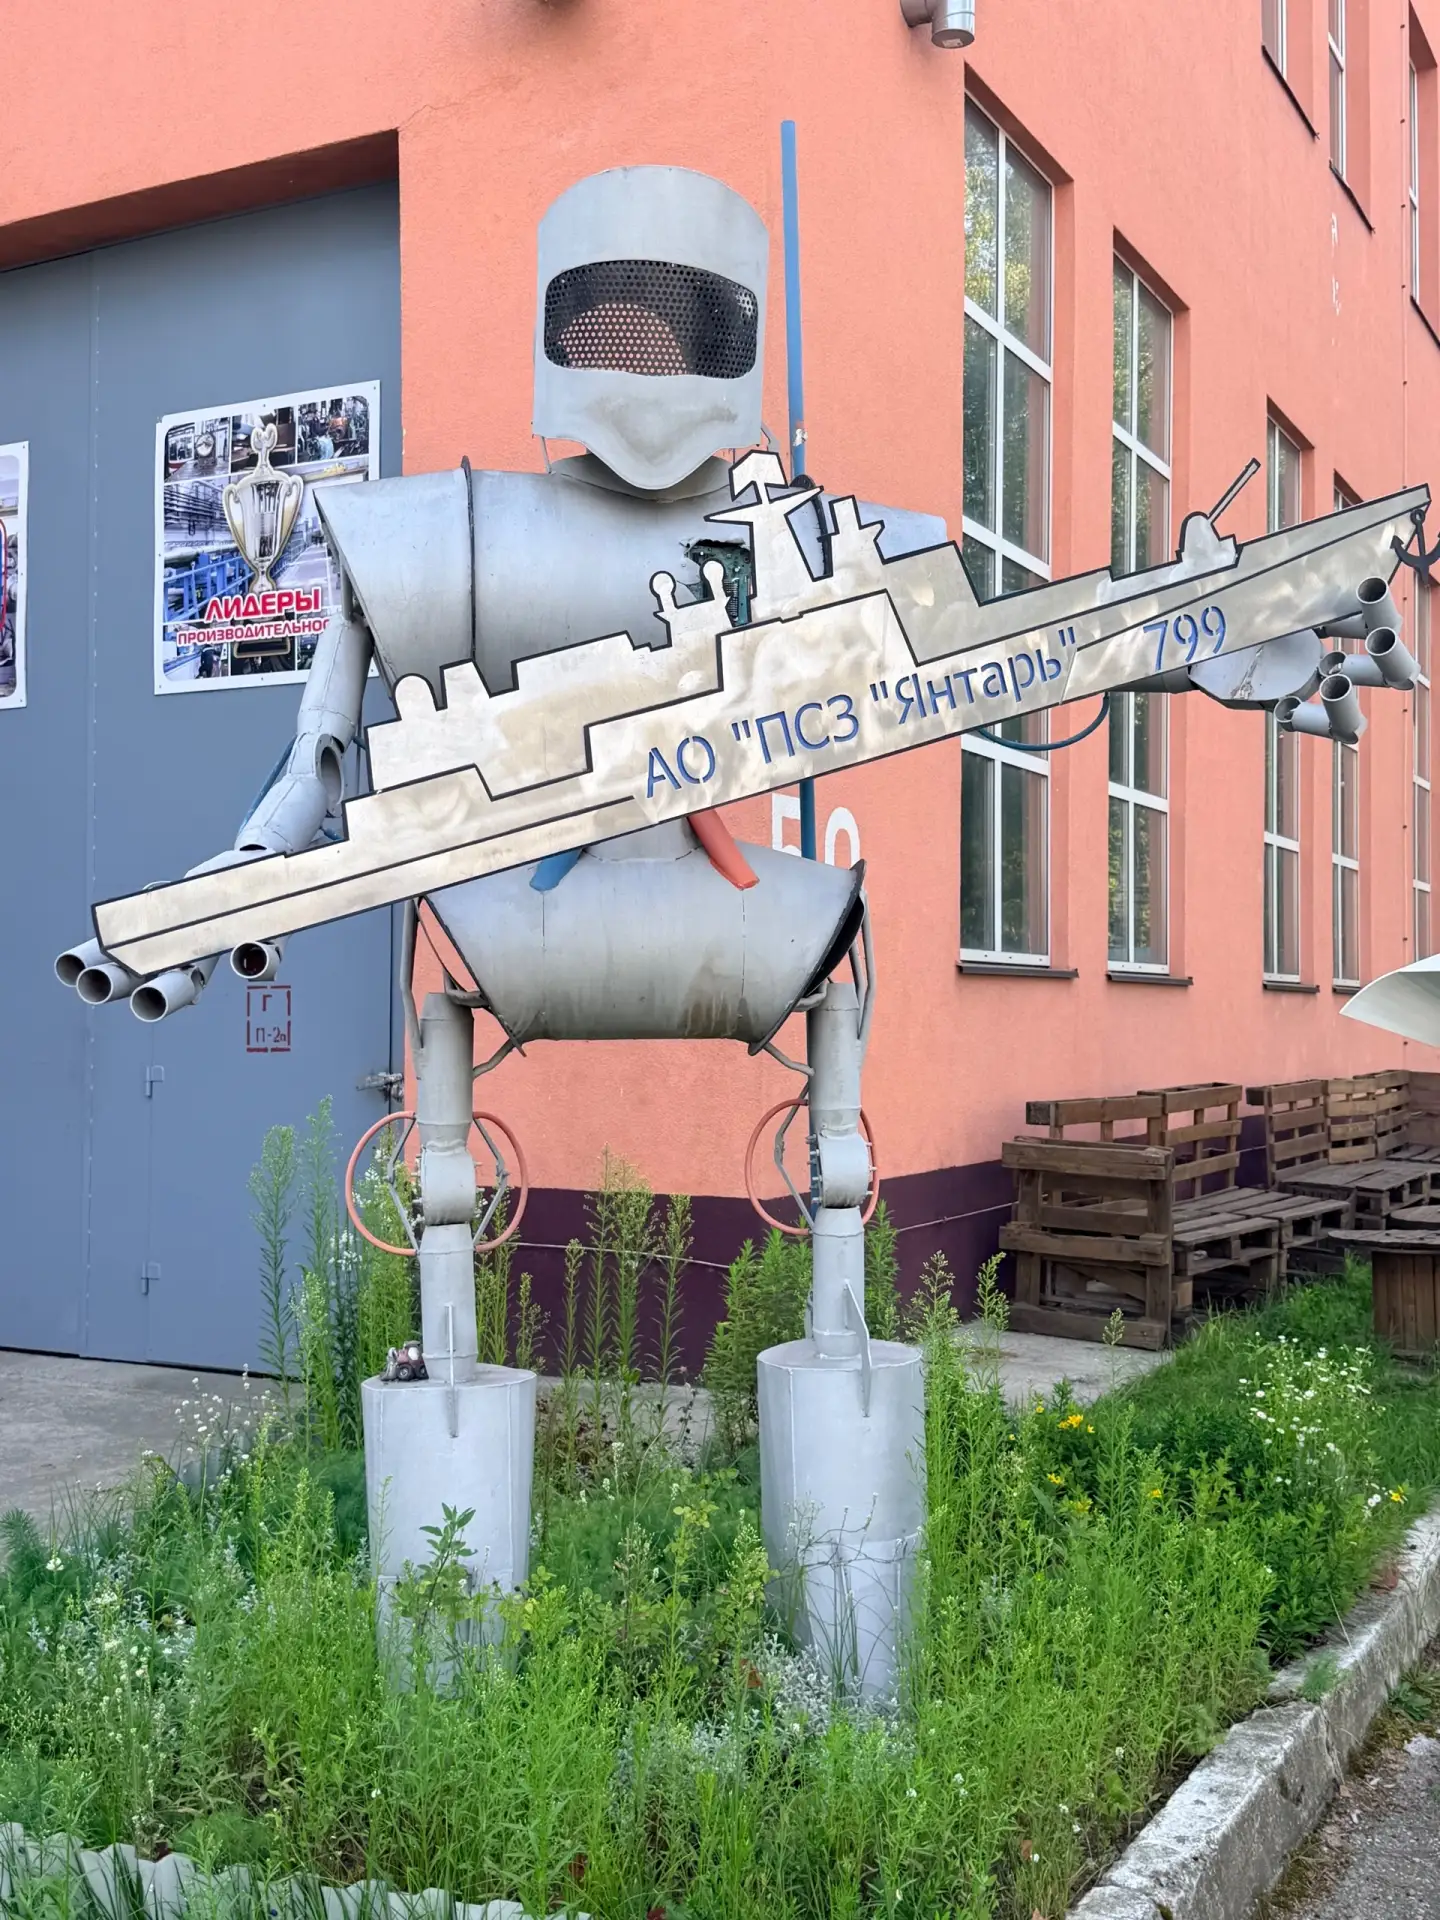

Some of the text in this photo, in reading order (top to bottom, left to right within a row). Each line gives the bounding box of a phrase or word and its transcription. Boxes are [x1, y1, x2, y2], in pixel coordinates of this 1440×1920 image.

[205, 588, 320, 621] ЛИДЕРЫ
[1143, 606, 1226, 671] 799
[646, 626, 1076, 798] АО "ПСЗ "Янтарь"
